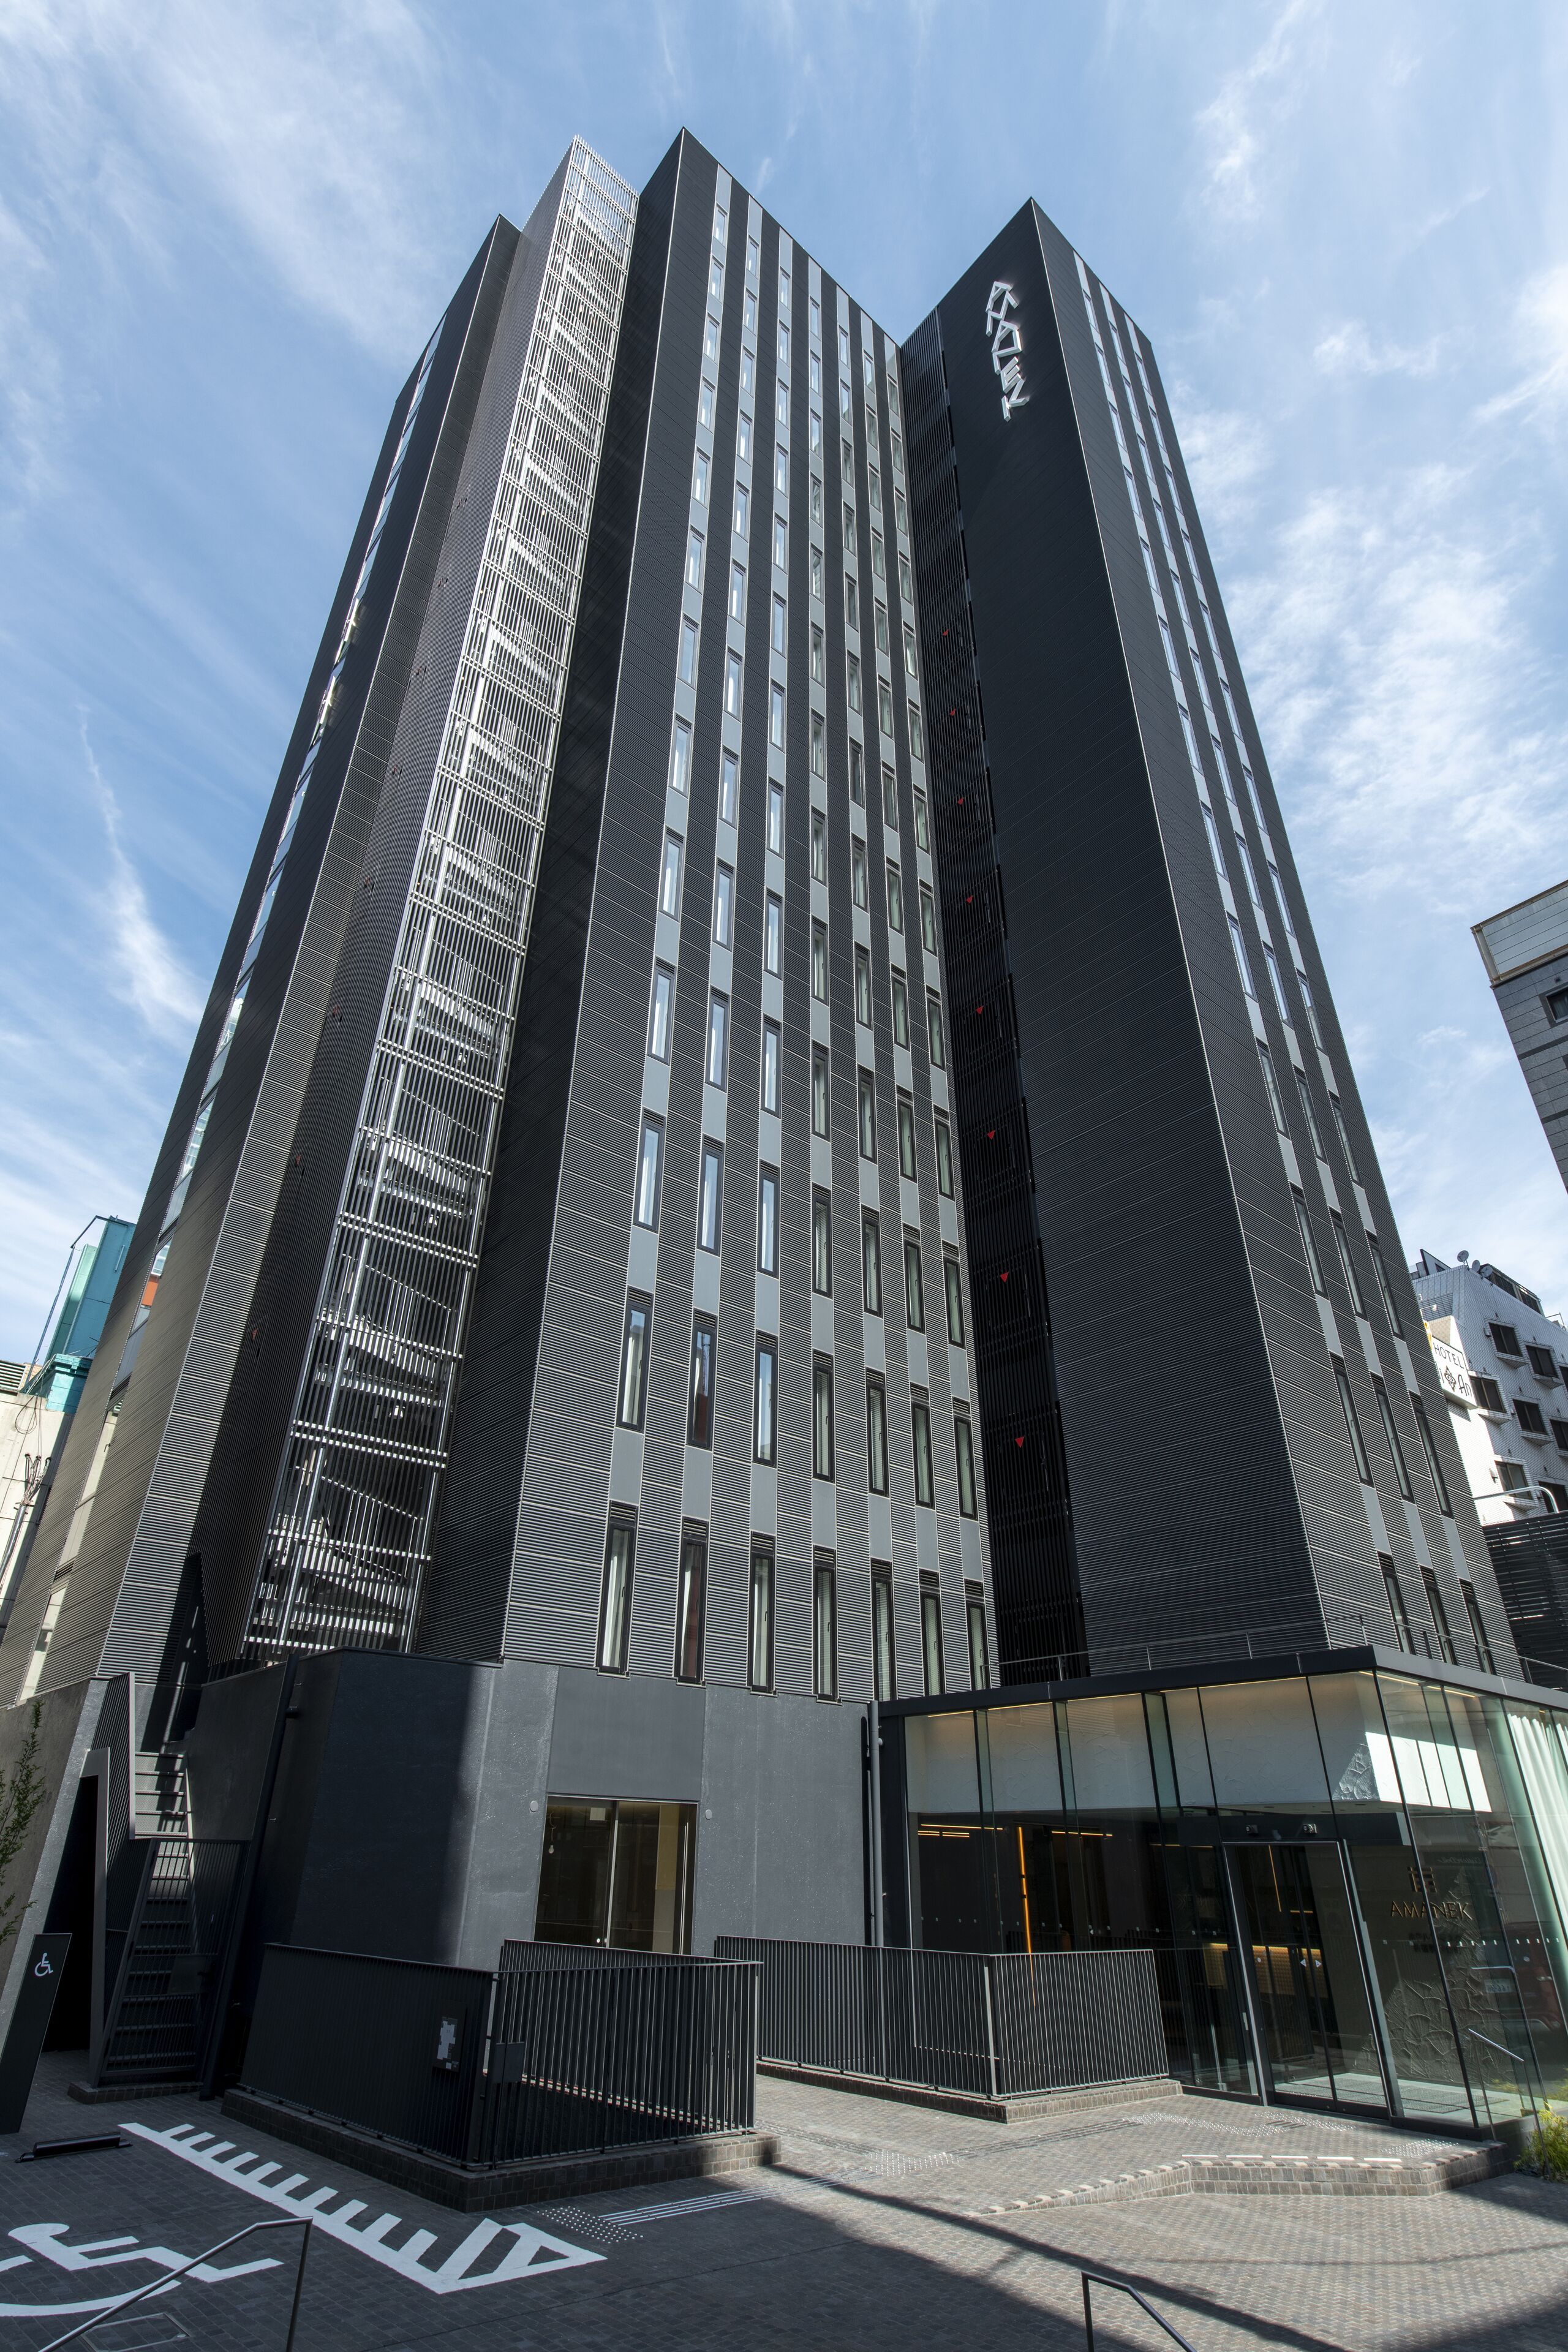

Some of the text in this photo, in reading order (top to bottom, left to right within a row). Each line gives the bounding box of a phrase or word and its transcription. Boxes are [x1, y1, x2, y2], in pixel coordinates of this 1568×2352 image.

[1433, 1342, 1464, 1370] HOTEL
[1457, 1374, 1472, 1397] An
[1391, 1901, 1473, 1920] AMANEK
